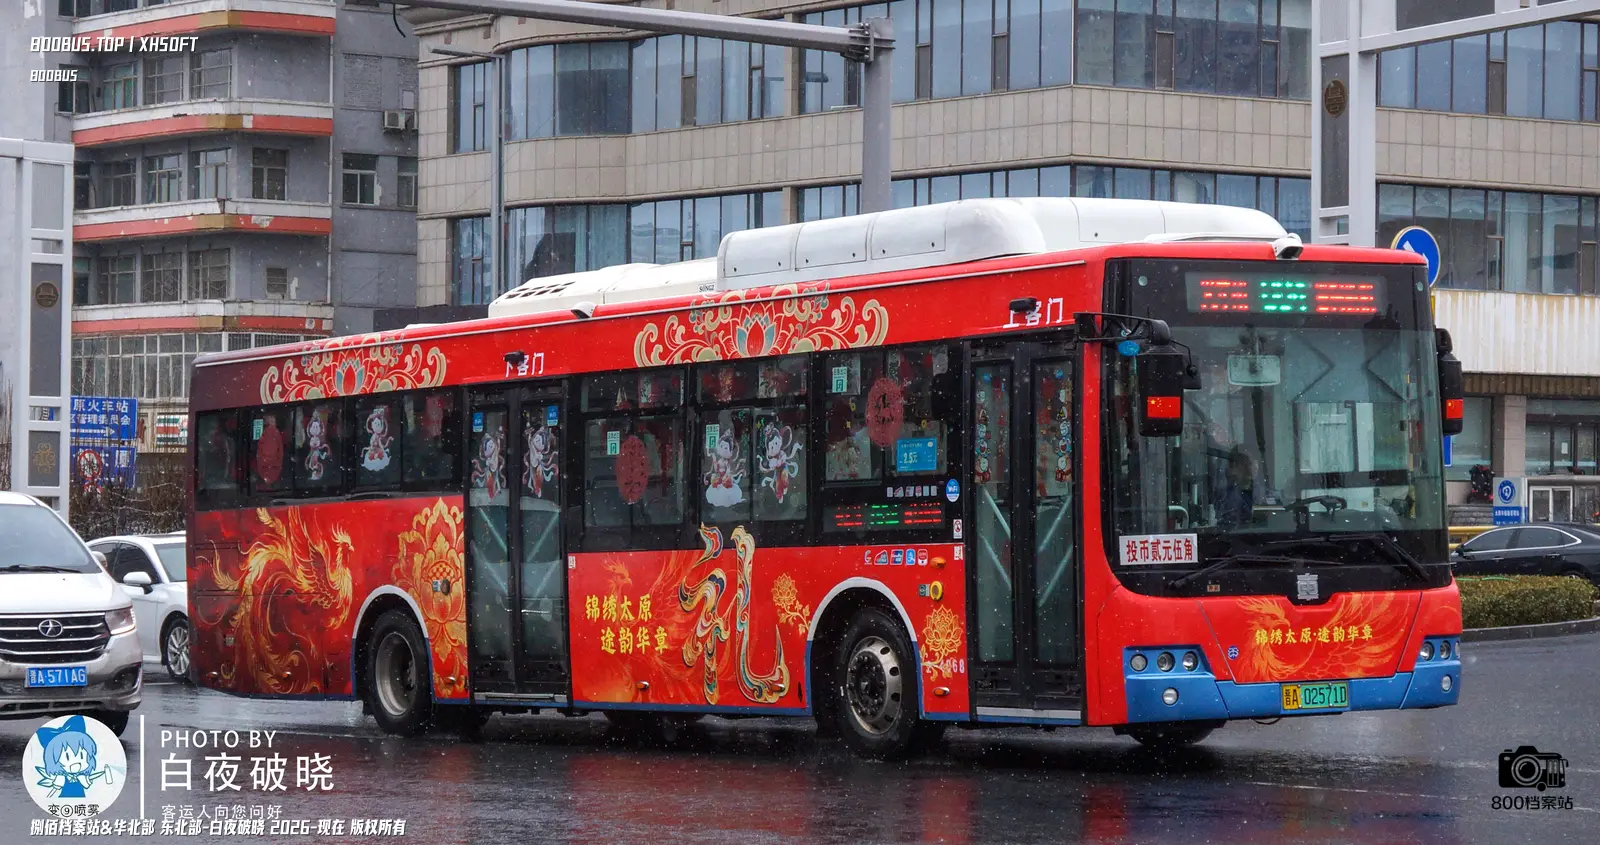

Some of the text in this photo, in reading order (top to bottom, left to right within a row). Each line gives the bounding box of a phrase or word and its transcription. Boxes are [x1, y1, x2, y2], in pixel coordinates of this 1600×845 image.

[1126, 538, 1193, 563] 投币贰元伍角
[584, 593, 653, 623] 锦绣太原
[600, 625, 669, 655] 途韵华章
